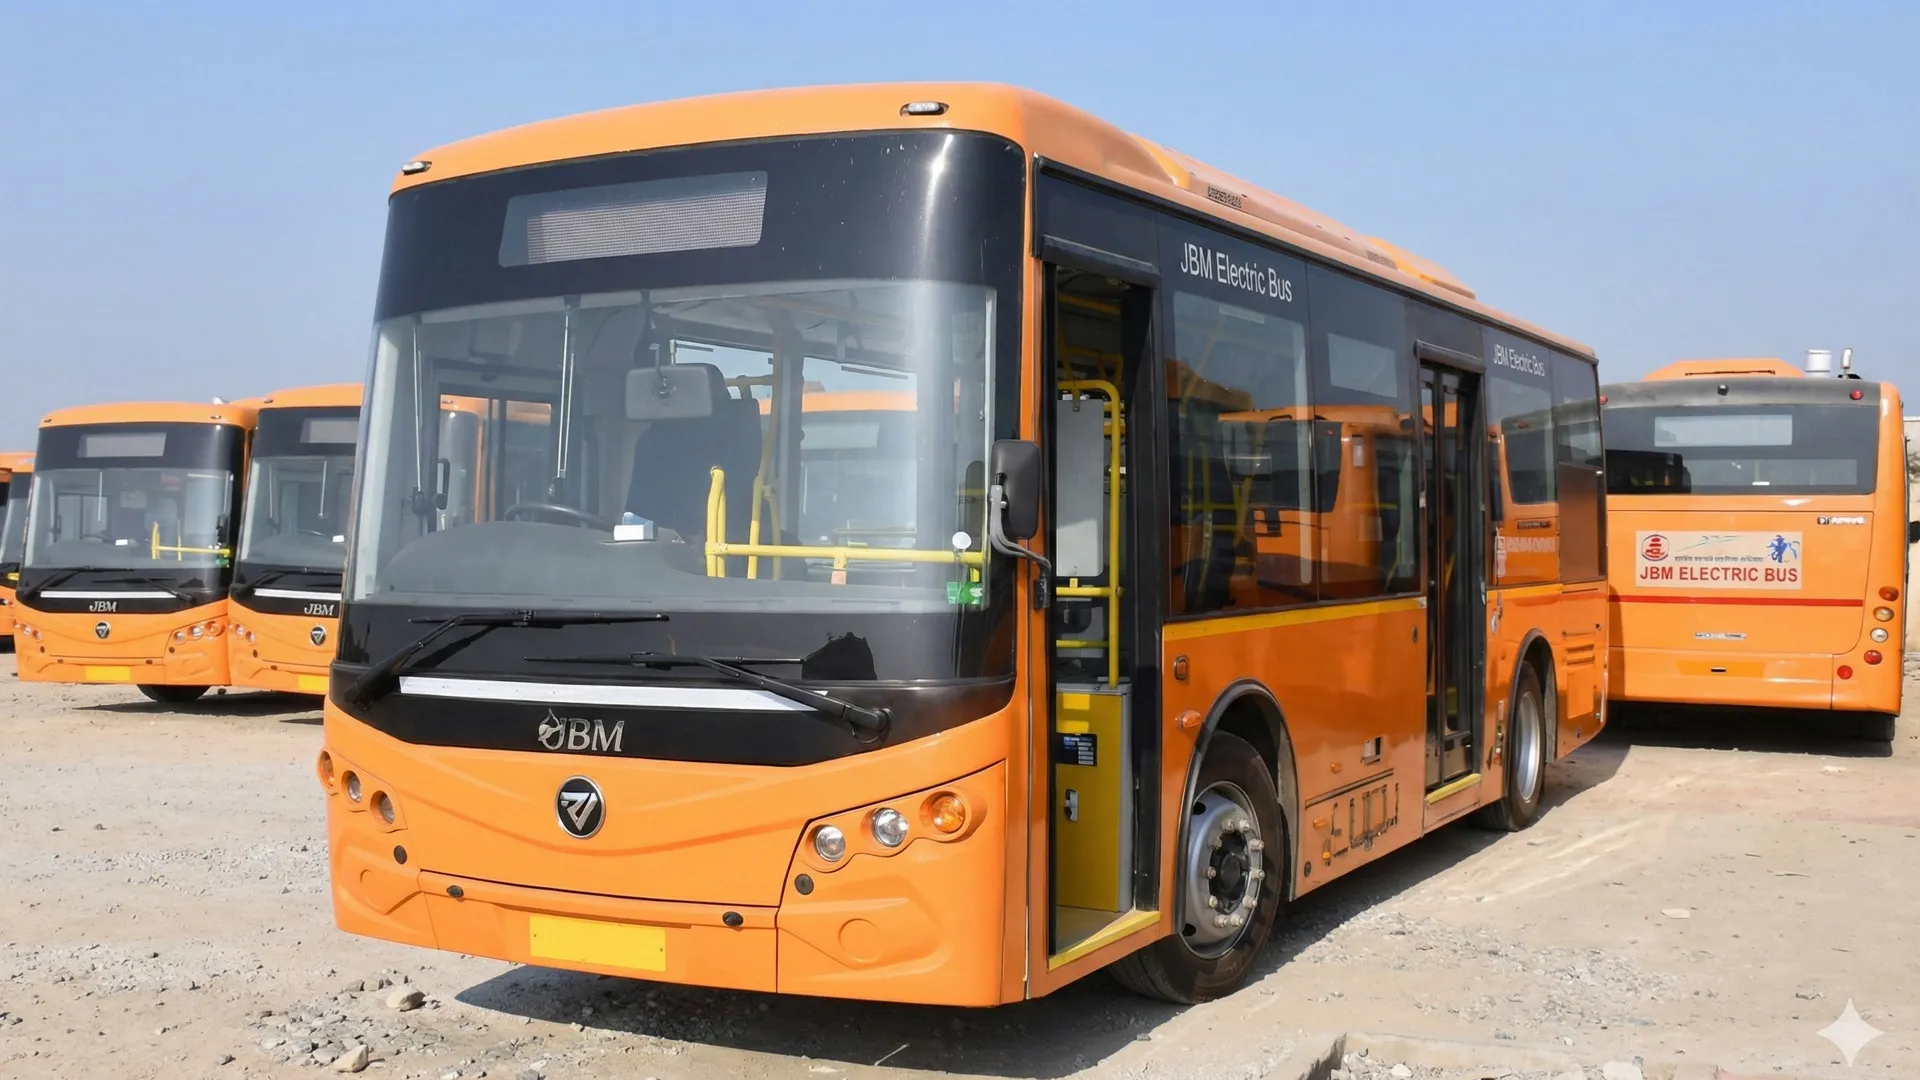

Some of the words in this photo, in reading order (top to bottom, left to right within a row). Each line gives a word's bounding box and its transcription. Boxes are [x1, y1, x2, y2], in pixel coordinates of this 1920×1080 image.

[1180, 242, 1213, 280] JBM
[1216, 251, 1266, 295] Electric
[1268, 267, 1293, 303] Bus
[1493, 344, 1509, 367] JBM
[1640, 566, 1673, 580] JBM
[1679, 567, 1758, 582] ELECTRIC
[1764, 567, 1798, 582] BUS
[89, 600, 118, 612] JBM
[304, 603, 335, 616] JBM
[538, 708, 625, 752] JBM
